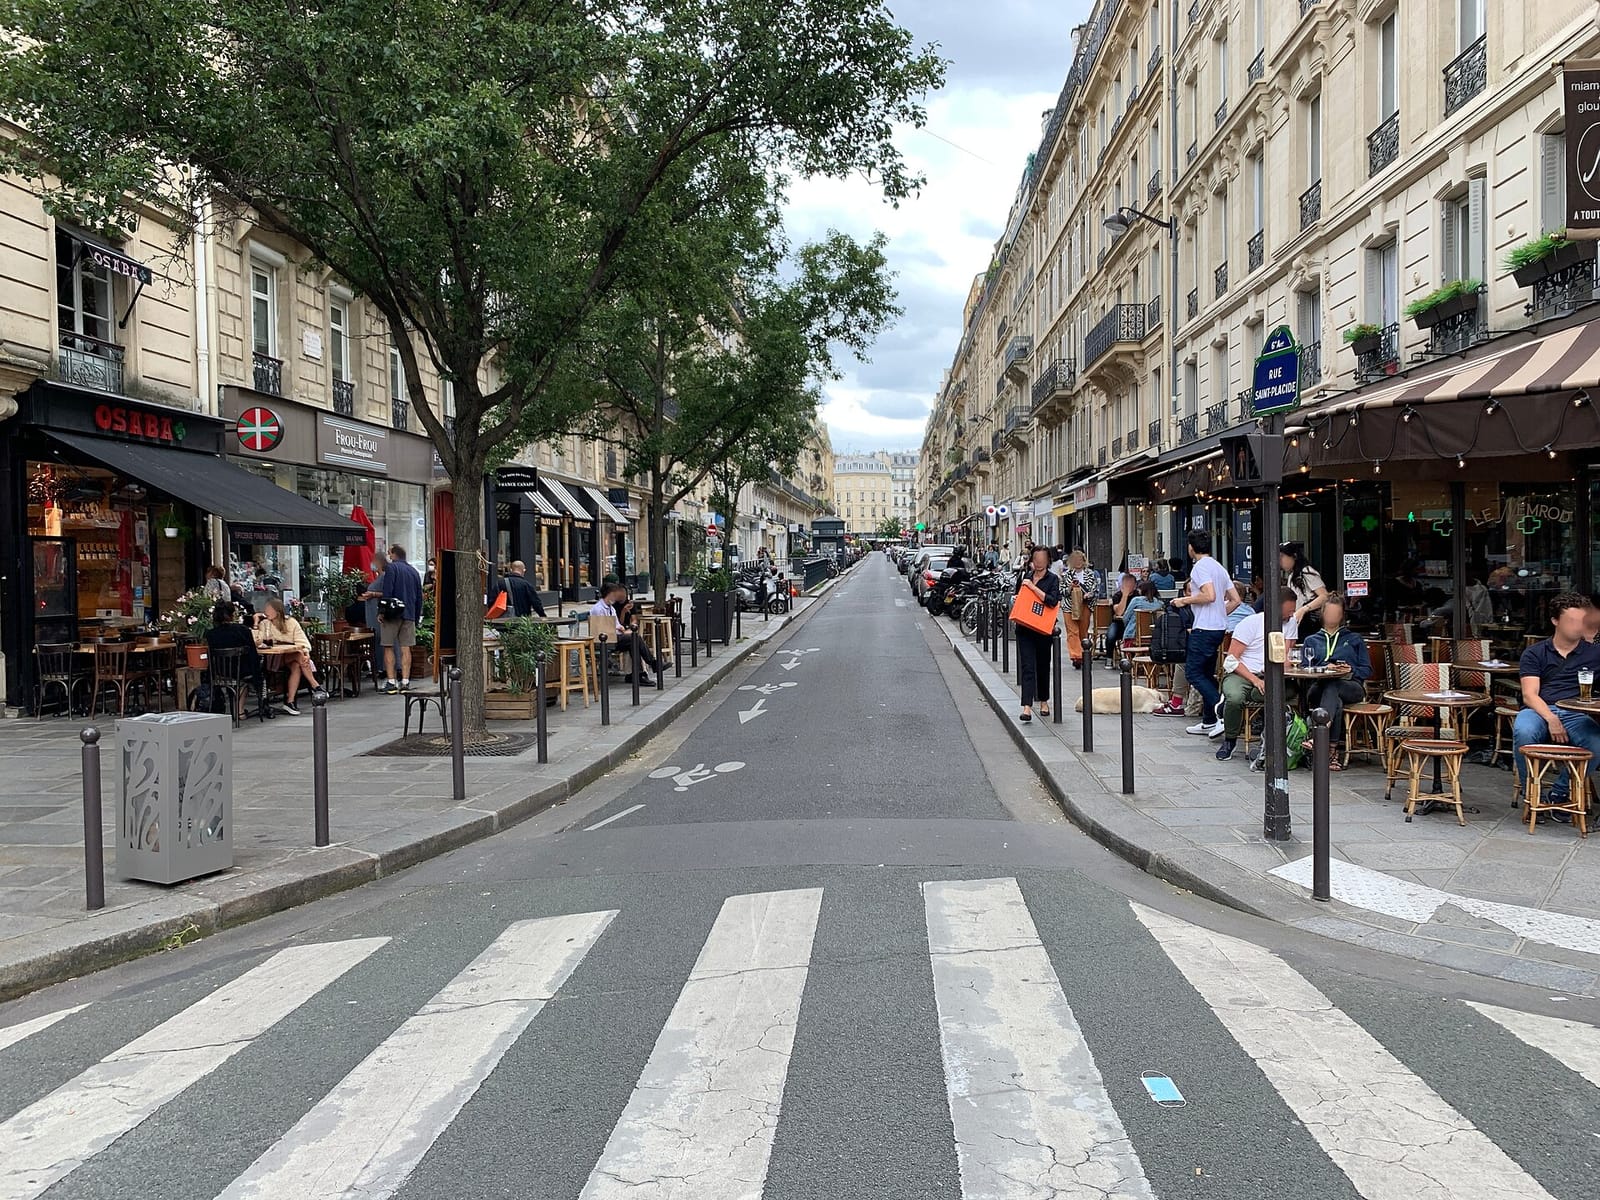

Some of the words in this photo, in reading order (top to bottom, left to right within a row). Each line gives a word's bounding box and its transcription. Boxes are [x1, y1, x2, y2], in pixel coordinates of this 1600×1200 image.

[1571, 81, 1600, 91] miam
[1577, 101, 1600, 114] glou
[93, 251, 138, 280] OSABA
[1268, 367, 1283, 380] RUE
[1254, 381, 1297, 401] SAINT-PLACIDE
[95, 404, 174, 441] OSABA
[1471, 507, 1495, 527] LE
